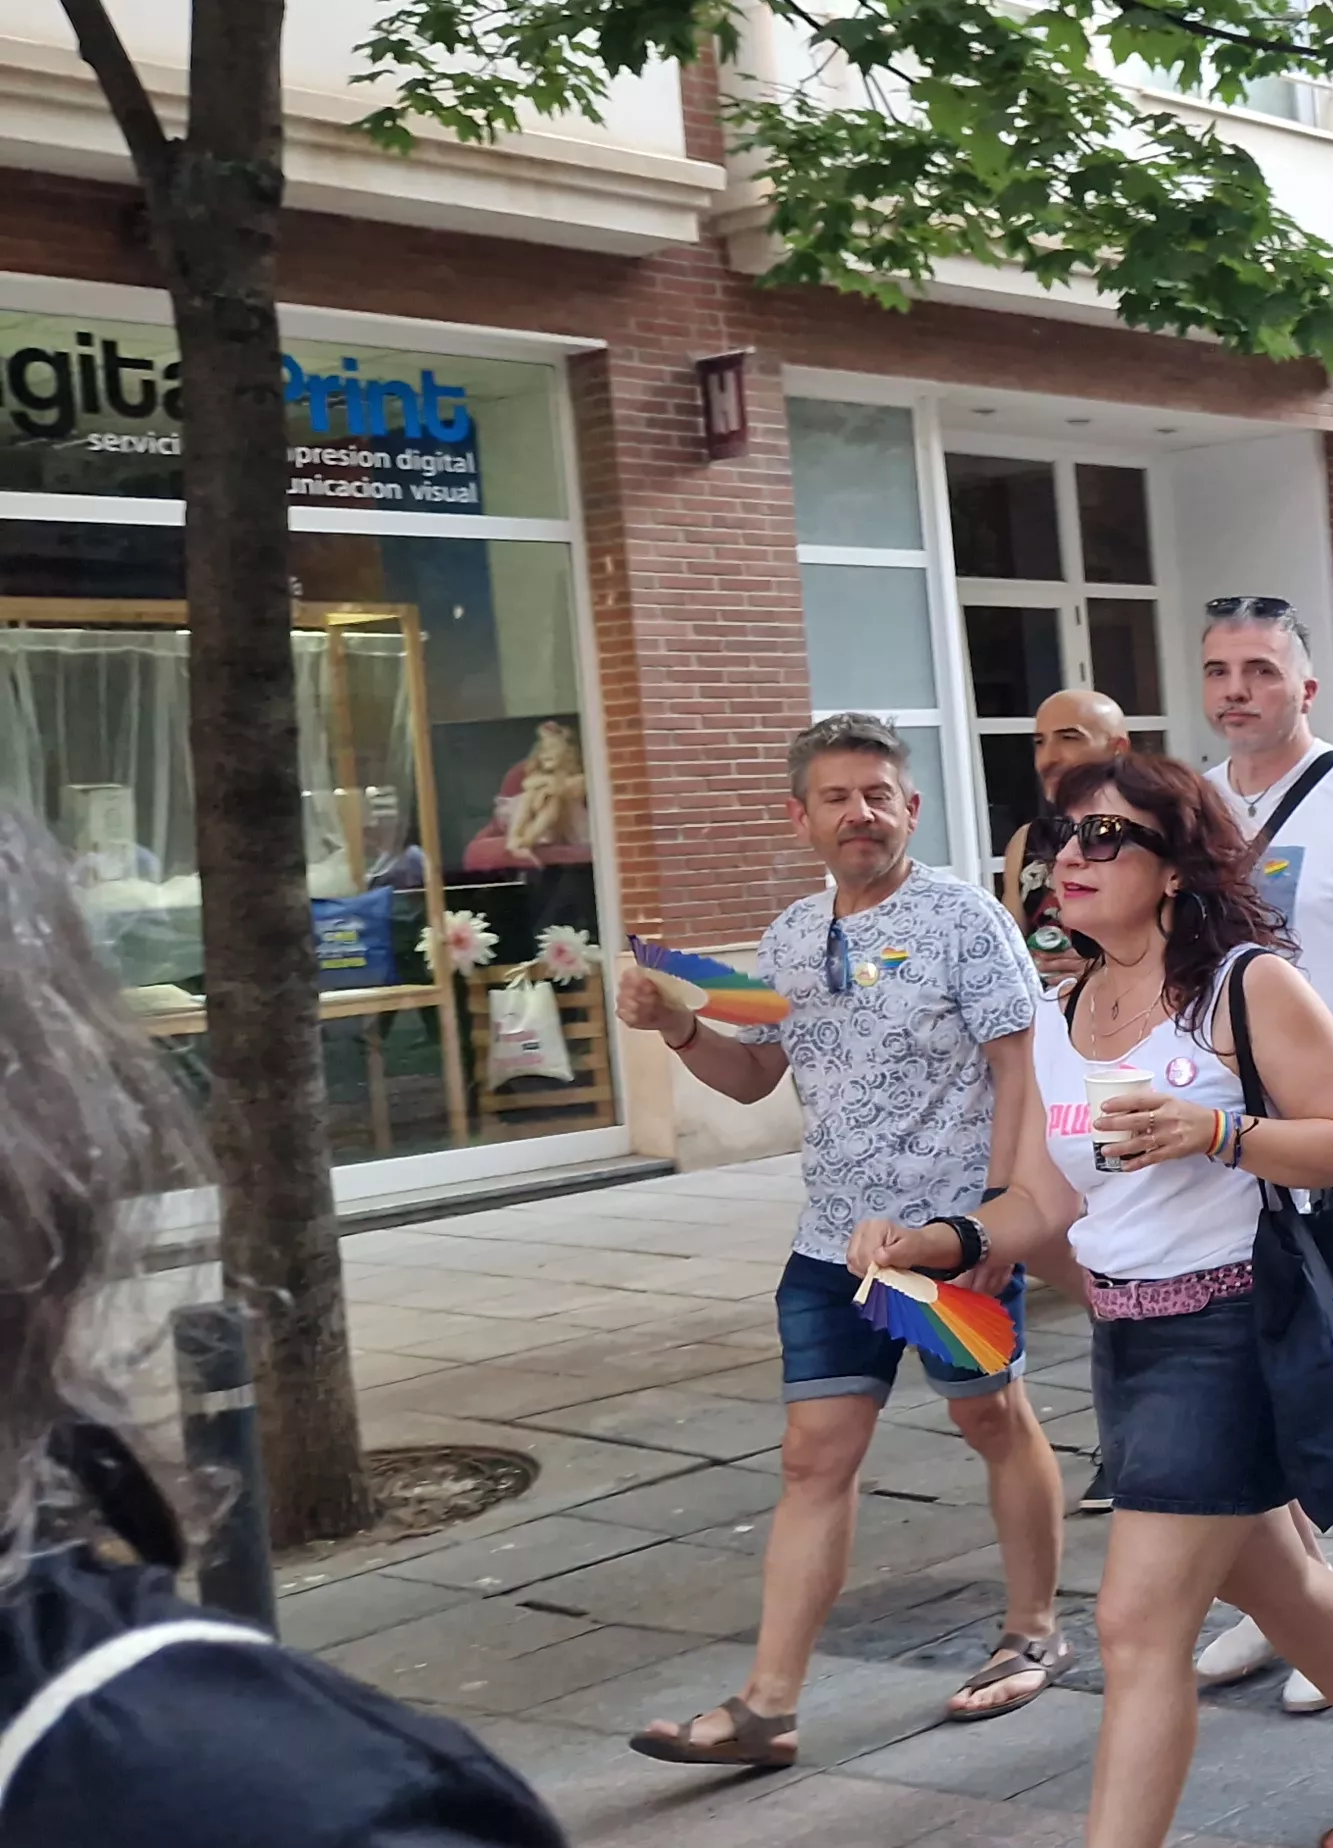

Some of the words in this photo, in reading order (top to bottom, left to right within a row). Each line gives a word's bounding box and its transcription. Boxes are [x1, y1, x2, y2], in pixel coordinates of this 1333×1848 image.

[0, 331, 184, 438] git
[87, 431, 182, 455] servici
[288, 445, 391, 468] presion
[396, 448, 476, 476] digital
[286, 474, 402, 500] unicacion
[410, 480, 479, 504] visual
[1049, 1103, 1091, 1137] PLU
